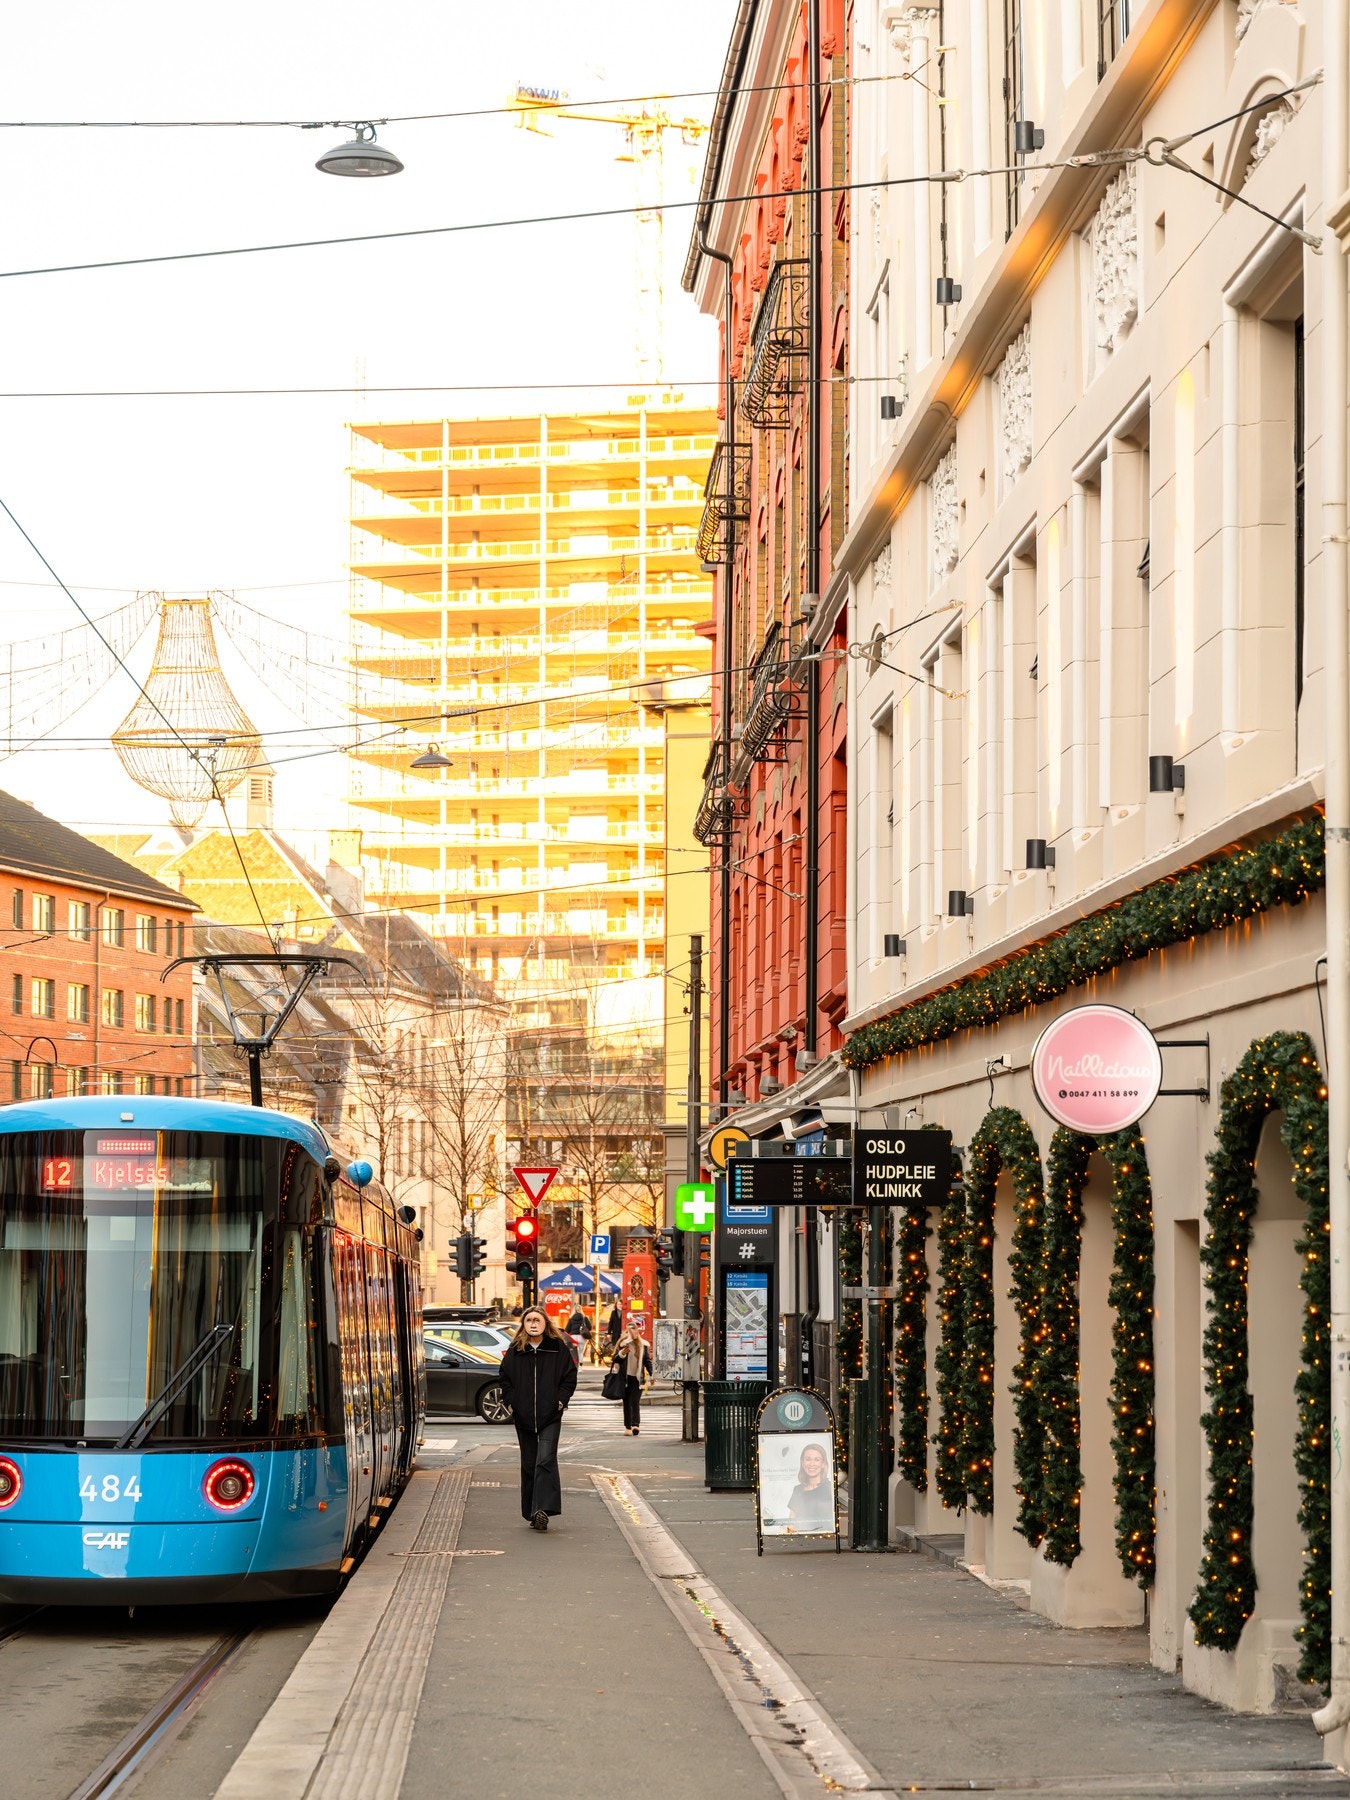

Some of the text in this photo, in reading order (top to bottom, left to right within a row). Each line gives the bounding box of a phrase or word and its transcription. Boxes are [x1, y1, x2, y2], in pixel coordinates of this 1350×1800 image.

[1048, 1054, 1152, 1085] Naillicious
[1069, 1090, 1139, 1098] 0047 411 58 899
[866, 1139, 906, 1154] OSLO
[46, 1161, 71, 1186] 12
[95, 1161, 168, 1188] Kjelsås
[866, 1165, 936, 1180] HUDPLEIE
[866, 1183, 922, 1198] KLINIKK
[726, 1227, 768, 1236] Majorstuen
[595, 1237, 605, 1251] P
[79, 1474, 142, 1502] 484
[83, 1532, 130, 1549] CAF
